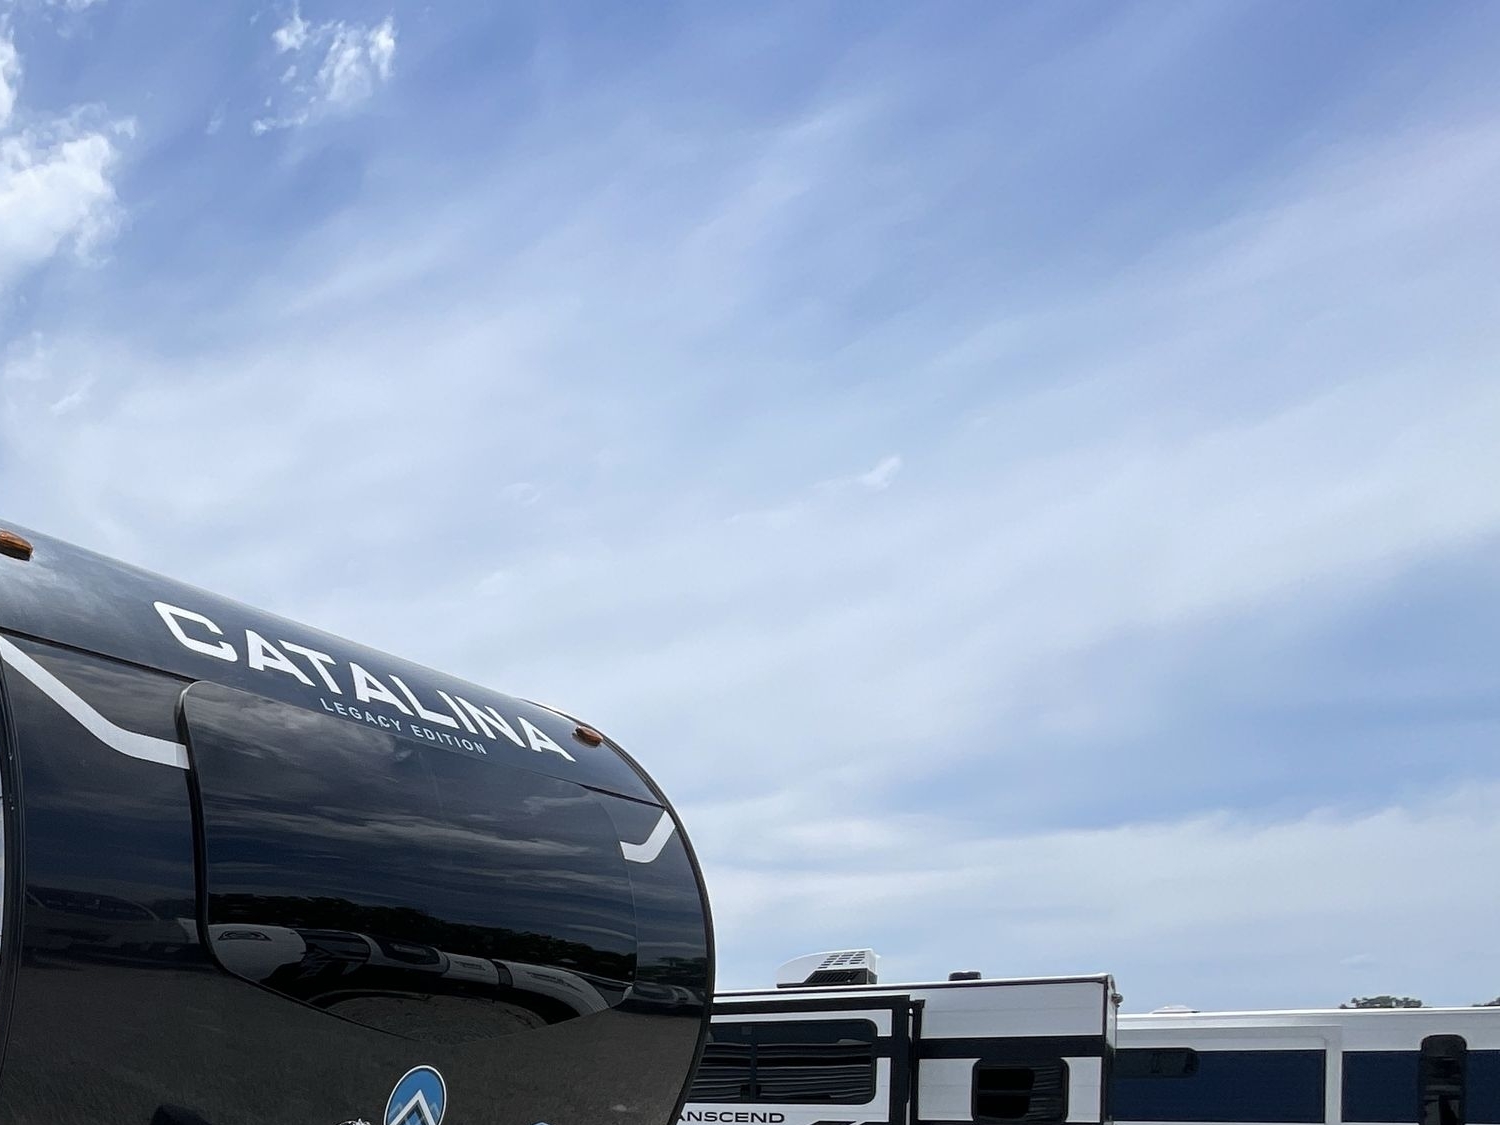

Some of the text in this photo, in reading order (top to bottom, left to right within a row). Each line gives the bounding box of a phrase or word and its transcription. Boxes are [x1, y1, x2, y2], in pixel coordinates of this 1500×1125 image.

[153, 601, 576, 762] CATALINA
[320, 698, 488, 755] LEGACY EDITION
